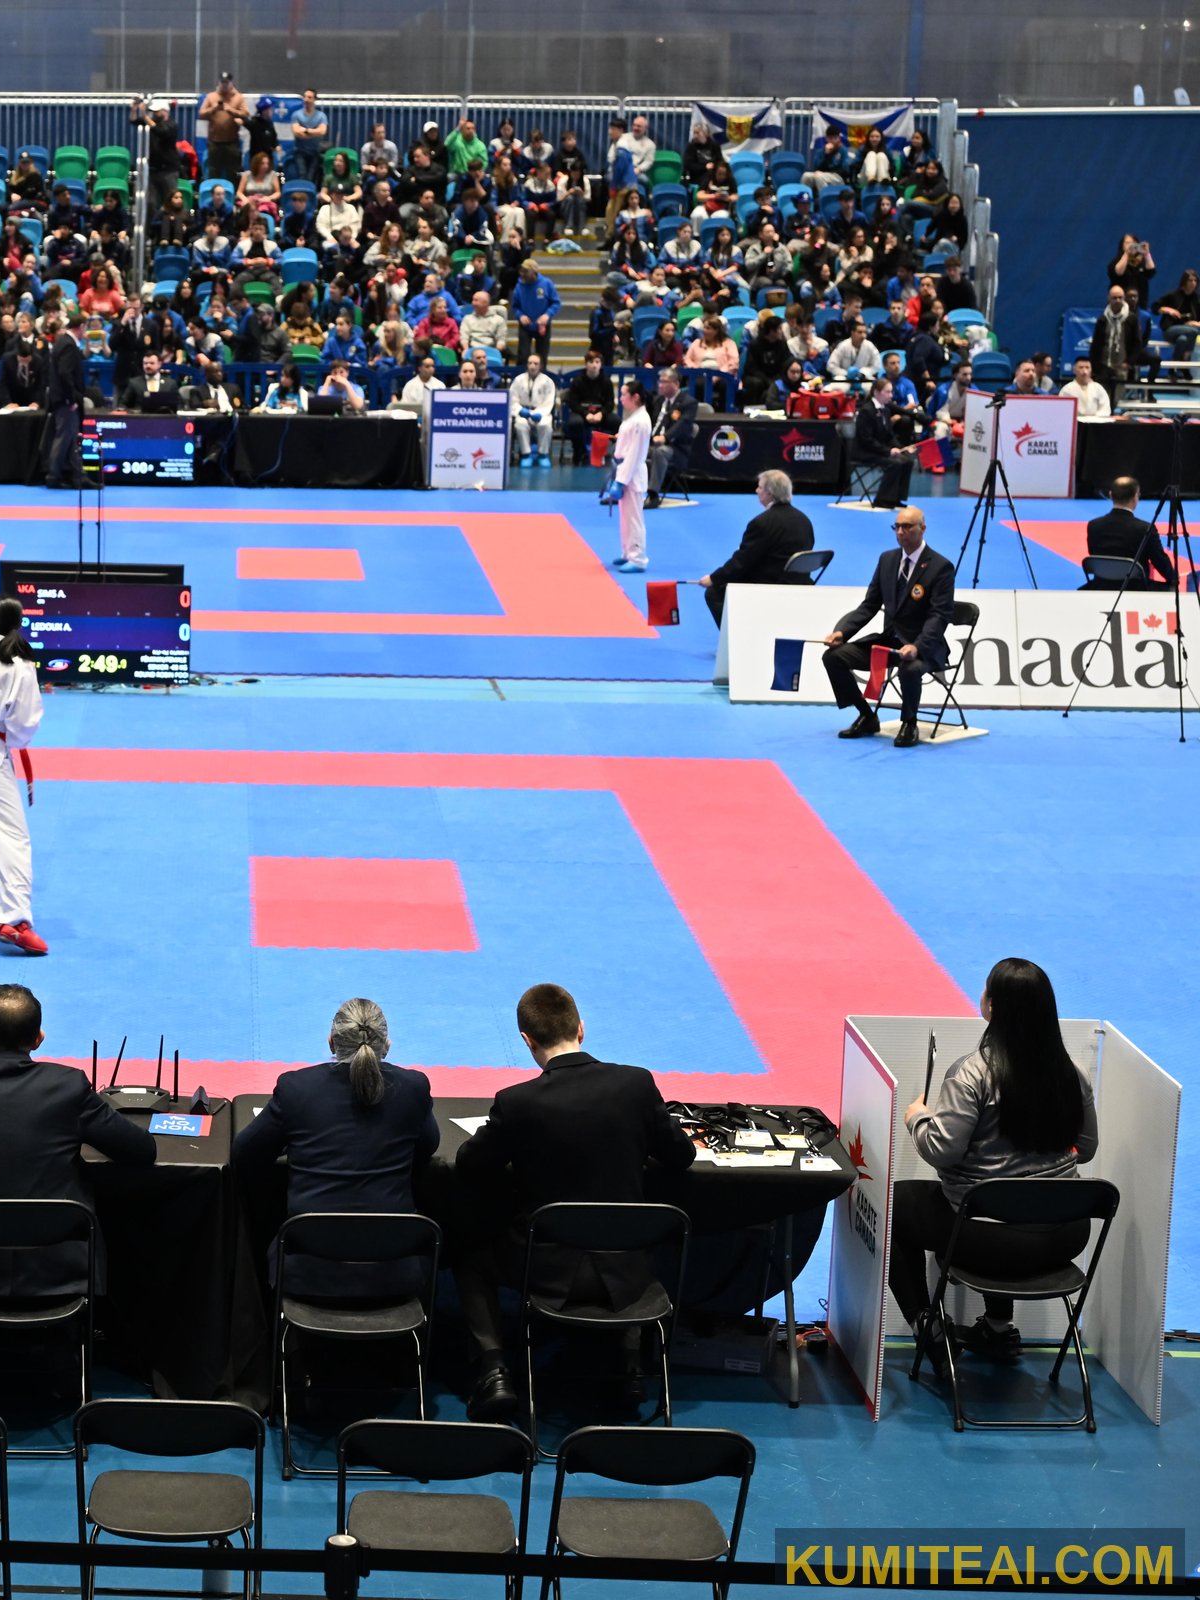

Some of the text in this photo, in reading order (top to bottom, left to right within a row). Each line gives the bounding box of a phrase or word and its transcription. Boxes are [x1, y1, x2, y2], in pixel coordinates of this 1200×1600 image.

[452, 406, 488, 416] COACH
[184, 421, 195, 435] 0
[794, 445, 825, 454] KARATE
[1027, 440, 1058, 448] KARATE
[794, 452, 825, 461] CANADA
[1027, 447, 1059, 456] CANADA
[179, 590, 191, 608] 0
[21, 616, 30, 627] O
[178, 623, 191, 641] 0
[850, 611, 1187, 688] nada
[154, 1124, 196, 1132] NON
[856, 1186, 878, 1233] KARATE
[855, 1209, 876, 1259] CANADA
